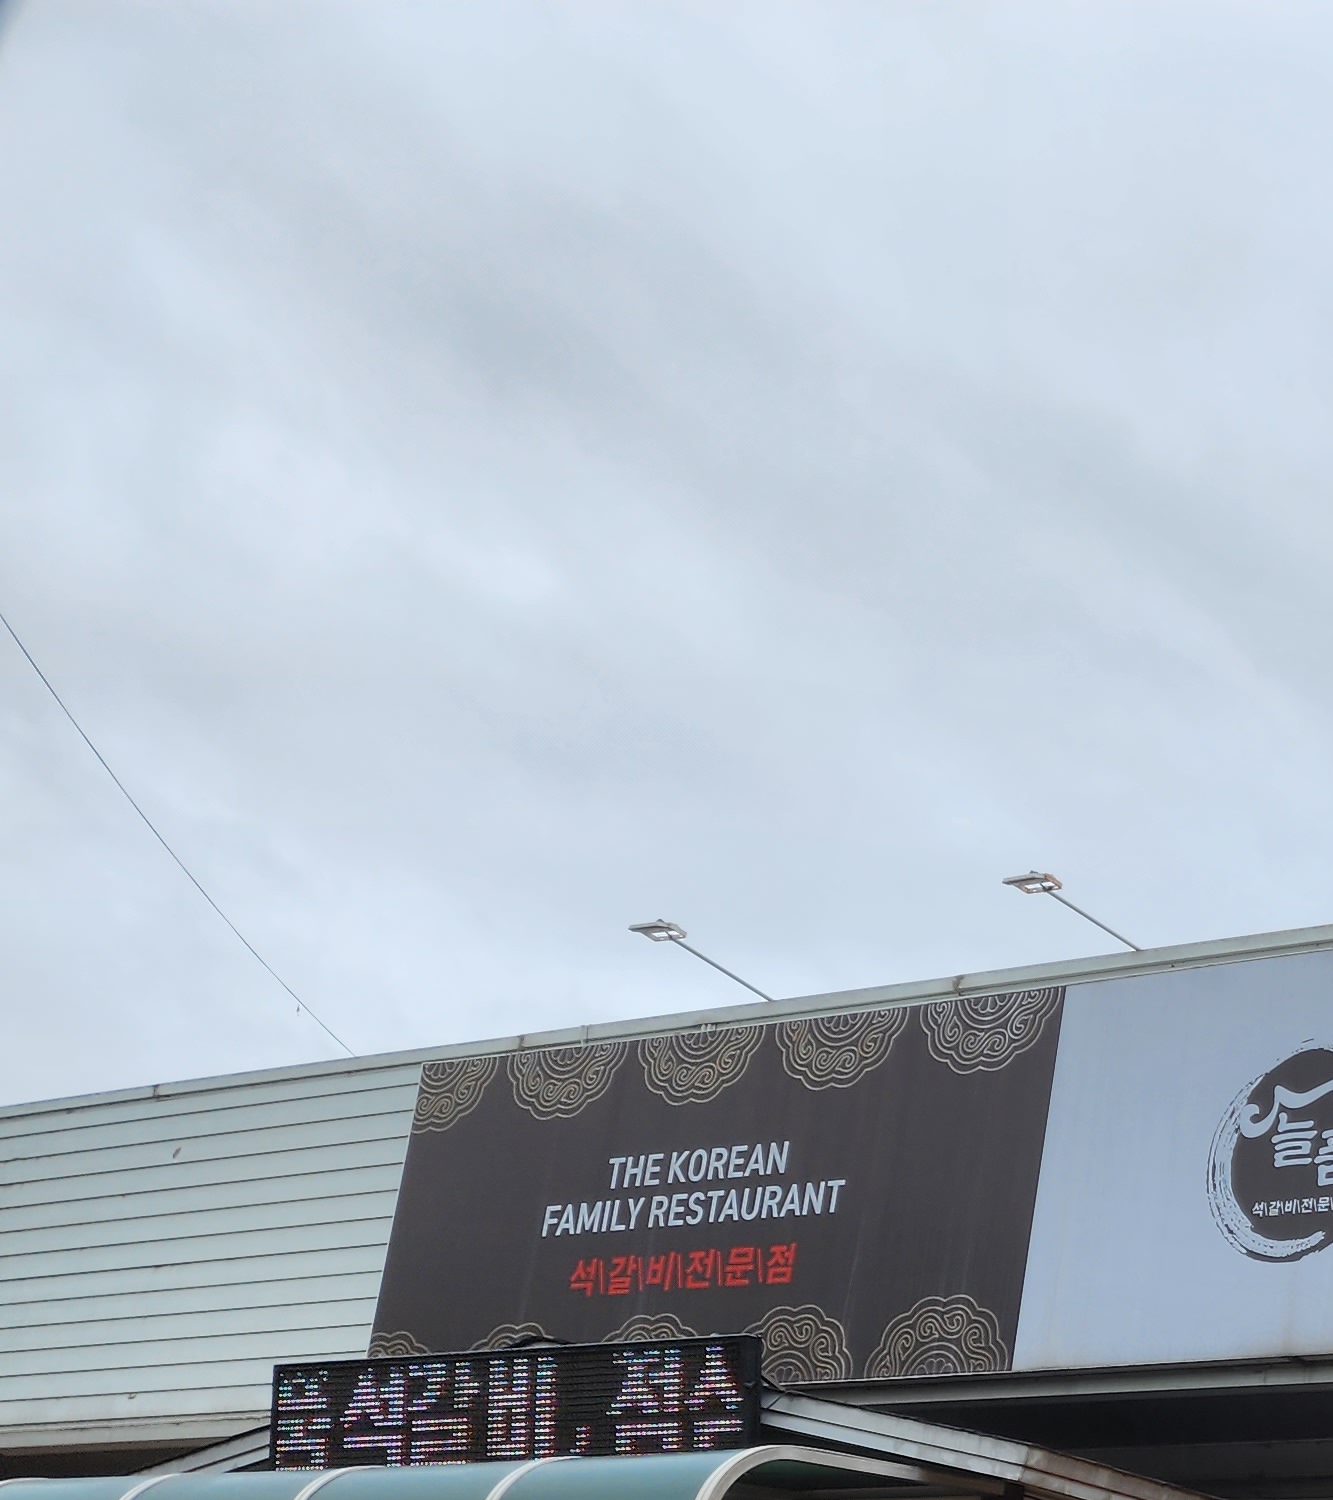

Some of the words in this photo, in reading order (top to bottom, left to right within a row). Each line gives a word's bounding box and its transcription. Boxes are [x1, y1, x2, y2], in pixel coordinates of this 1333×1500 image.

[608, 1153, 664, 1189] THE
[667, 1140, 791, 1185] KOREAN
[541, 1196, 644, 1238] FAMILY
[647, 1179, 846, 1229] RESTAURANT
